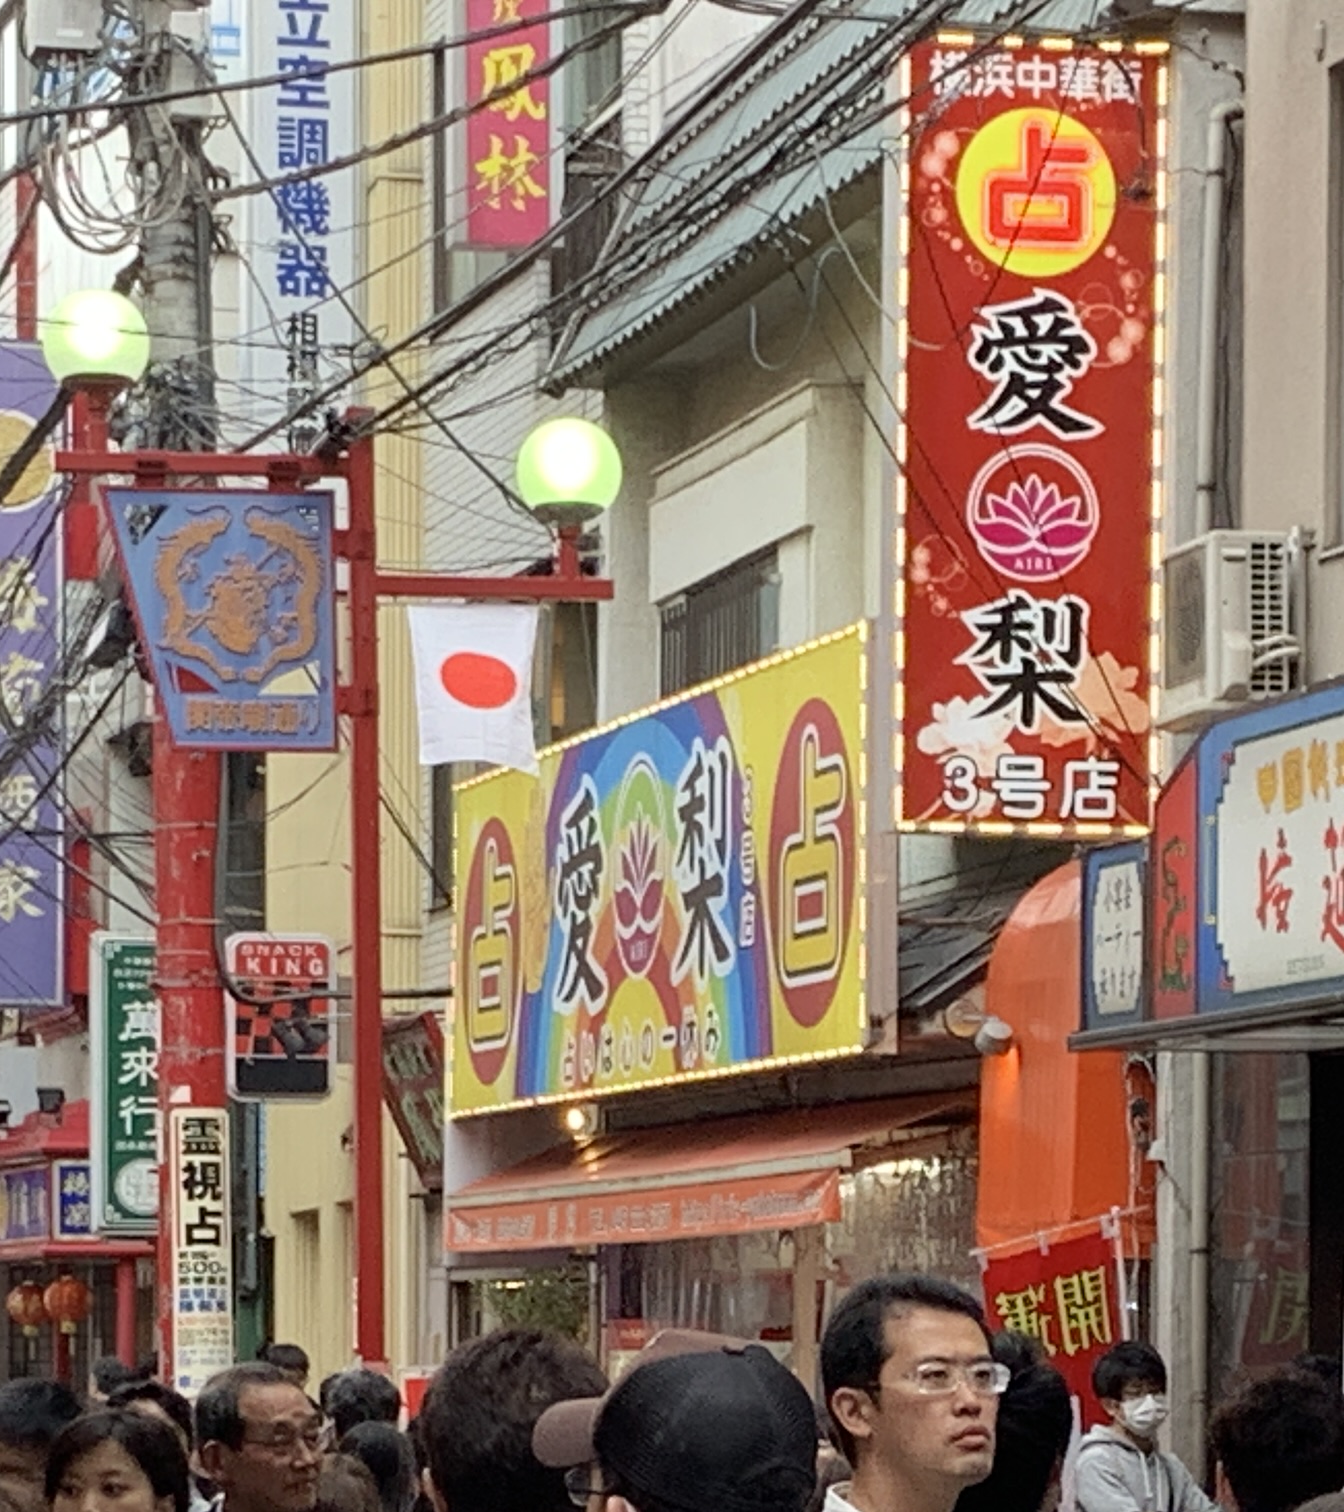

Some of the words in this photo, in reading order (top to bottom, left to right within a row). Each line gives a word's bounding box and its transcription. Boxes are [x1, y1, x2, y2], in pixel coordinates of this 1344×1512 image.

[929, 51, 1143, 104] 横浜中華街
[985, 122, 1095, 250] 占
[942, 757, 1120, 821] 3号店
[780, 724, 845, 986] 占
[240, 943, 317, 957] SNACK
[245, 957, 325, 977] KING
[470, 837, 518, 1052] 占
[182, 1117, 223, 1247] 霊視占
